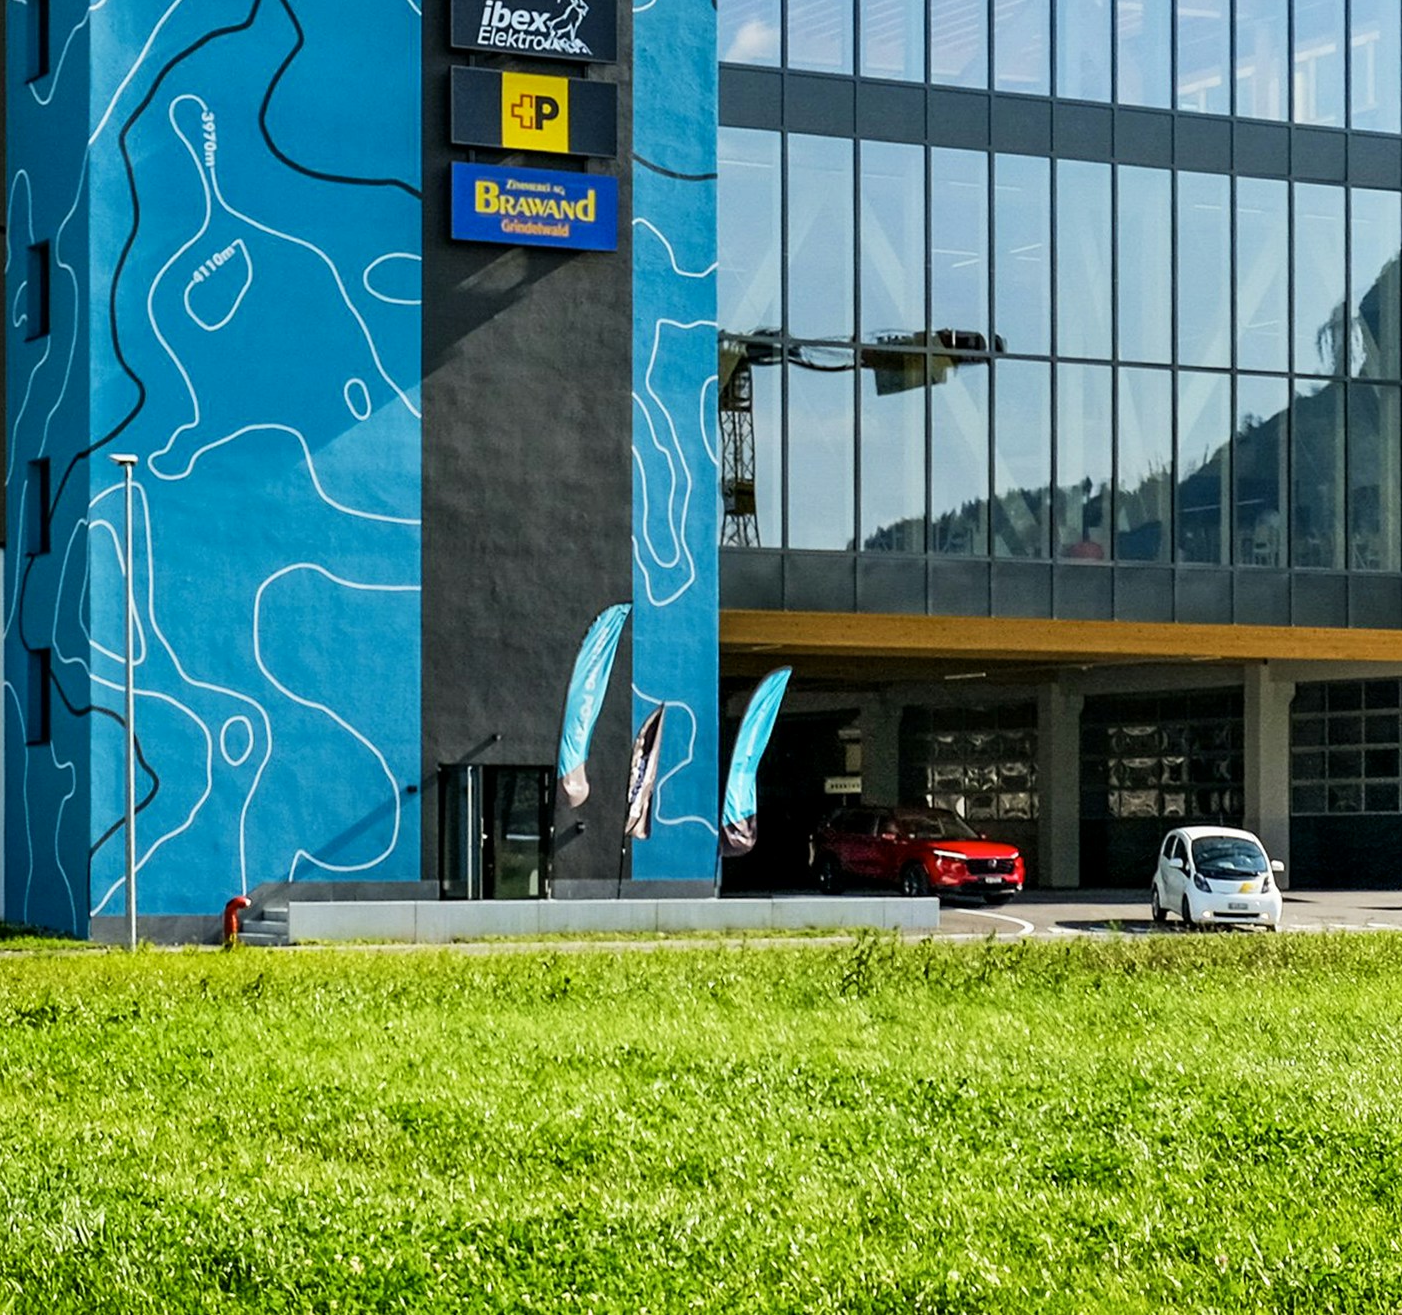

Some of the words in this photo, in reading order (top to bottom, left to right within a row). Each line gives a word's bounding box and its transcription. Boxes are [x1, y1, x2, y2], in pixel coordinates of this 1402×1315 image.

[481, 0, 551, 33] ibex
[477, 26, 546, 51] Elektro
[534, 95, 559, 131] P
[201, 111, 217, 167] 3970m
[192, 245, 236, 284] 4110m
